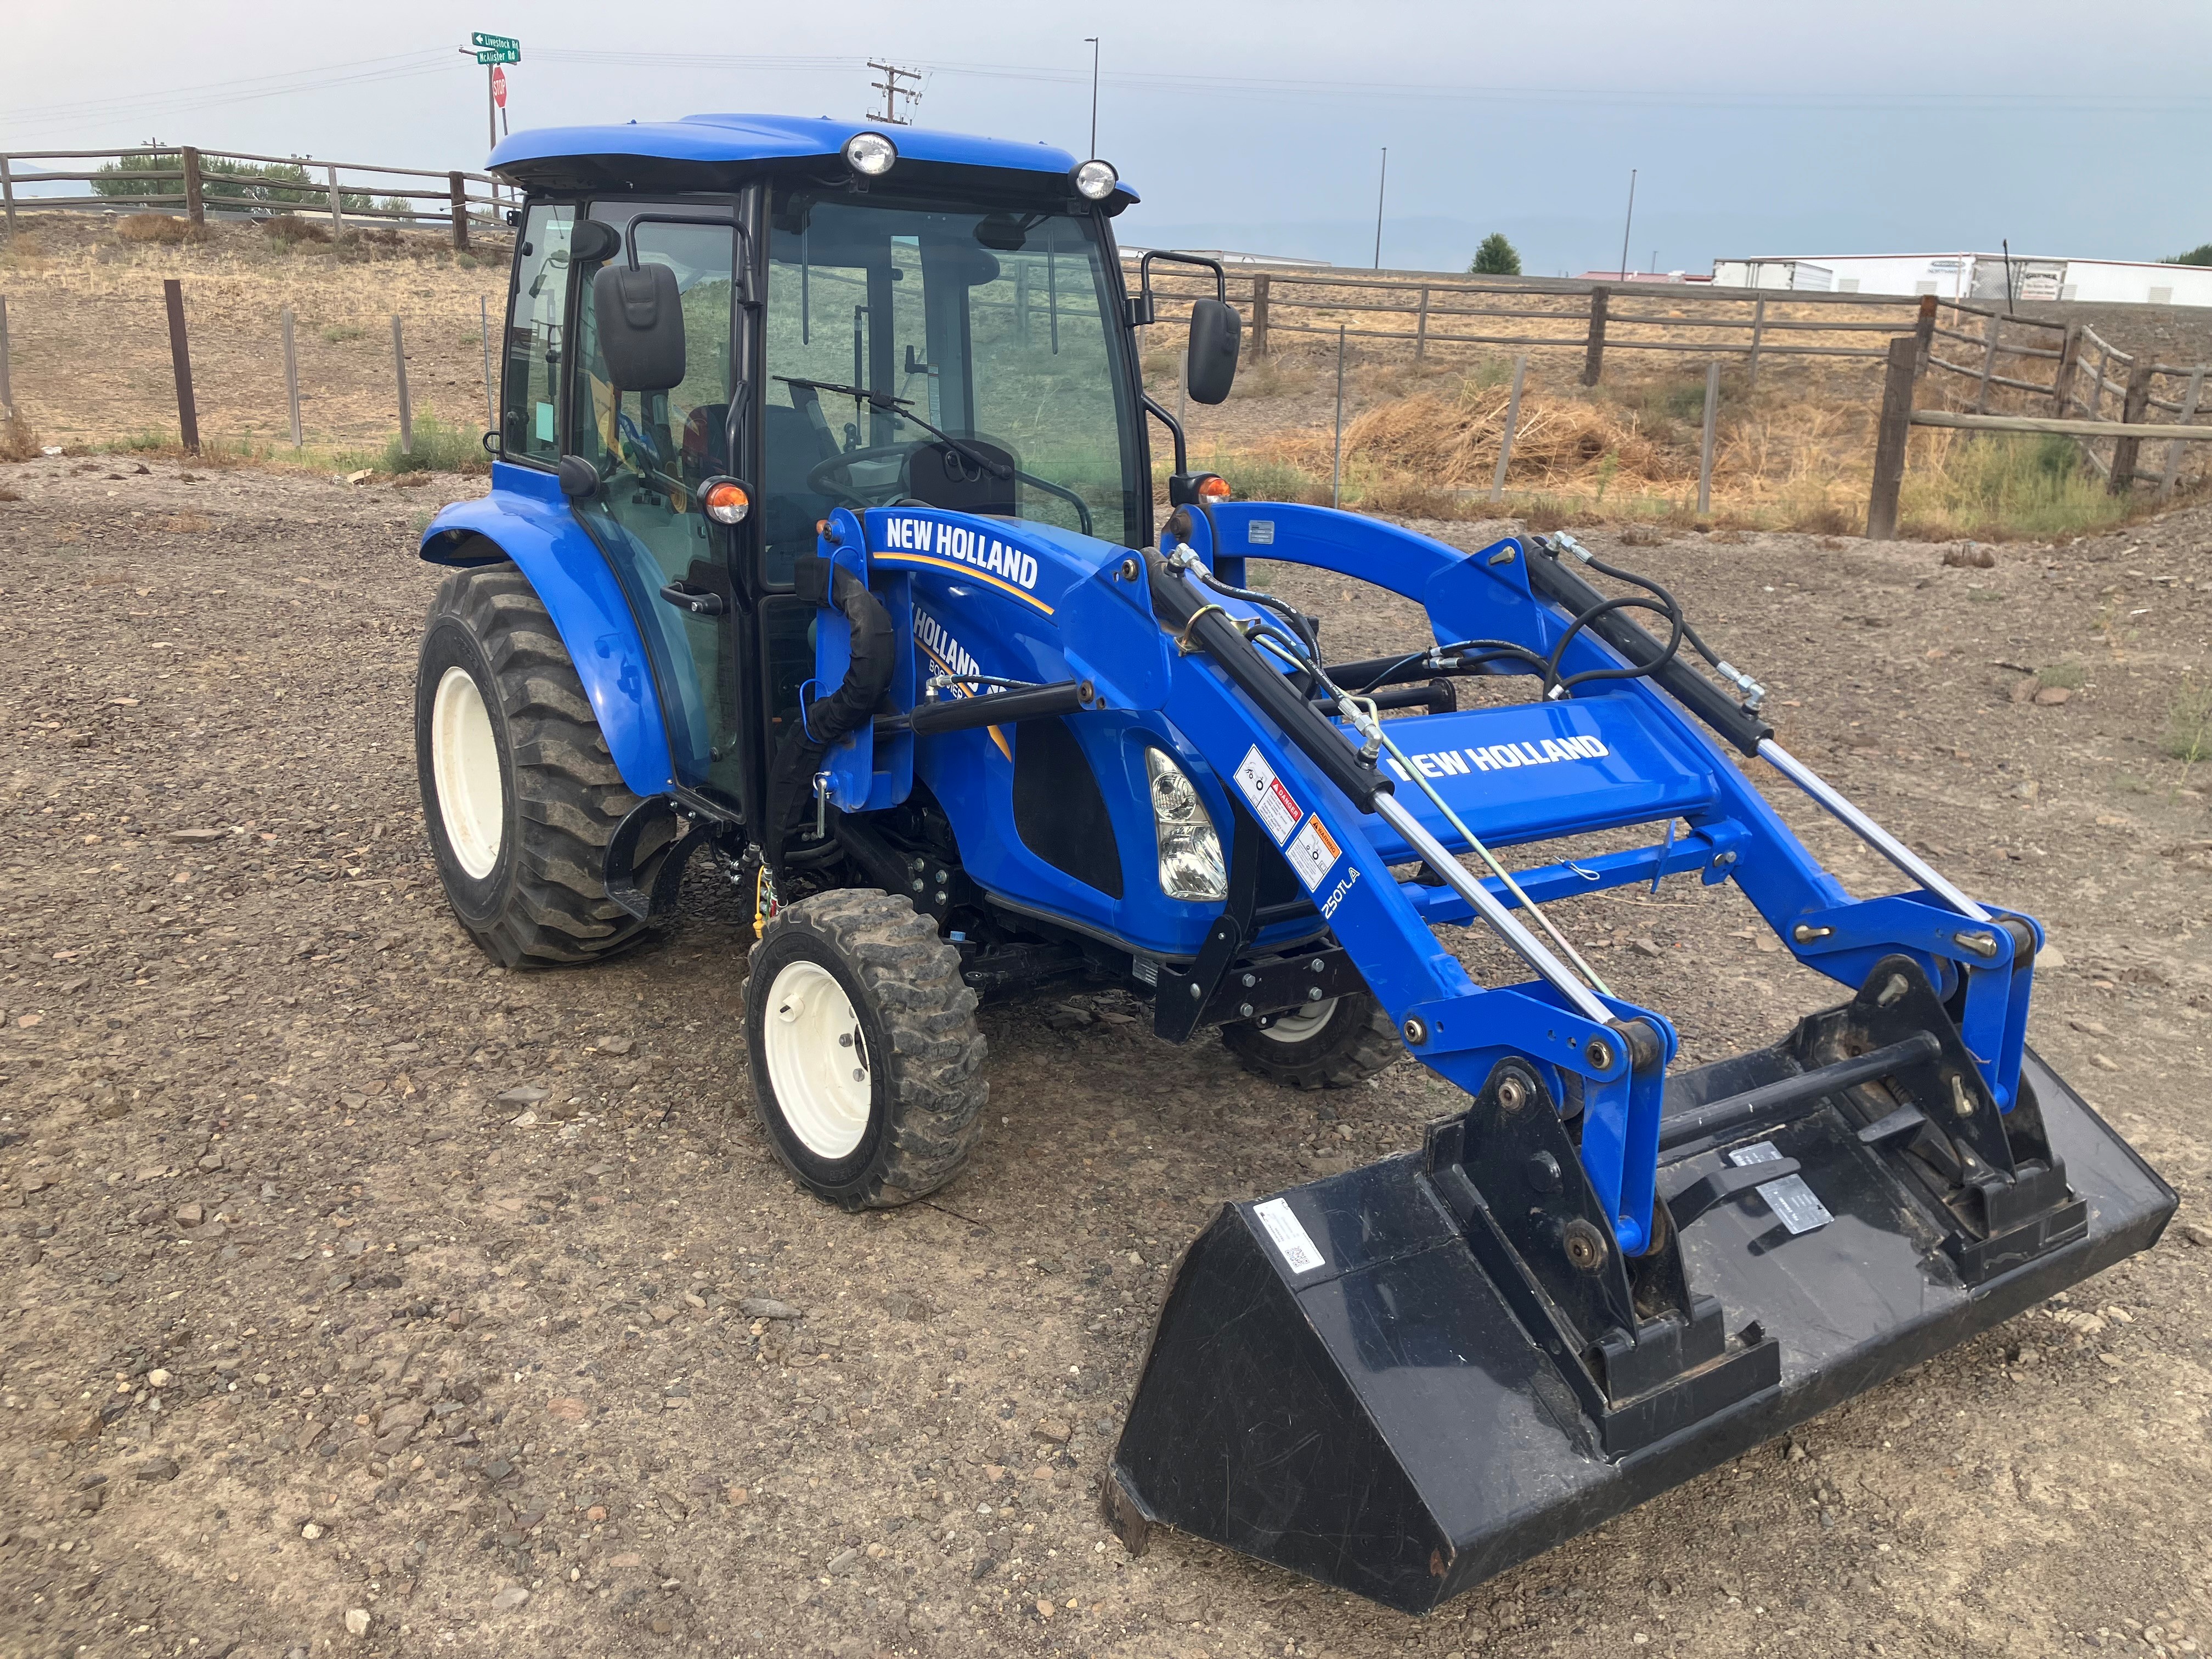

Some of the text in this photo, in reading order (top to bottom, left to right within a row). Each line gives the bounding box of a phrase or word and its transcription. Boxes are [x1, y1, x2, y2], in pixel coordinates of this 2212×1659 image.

[484, 36, 518, 49] Livestock Rd
[507, 50, 515, 60] Rd
[493, 78, 505, 96] STOP
[887, 518, 1037, 589] NEW HOLLAND
[914, 607, 979, 692] HOLLAND
[1386, 735, 1610, 781] NEW HOLLAND
[1277, 789, 1299, 817] DANGER
[1318, 827, 1336, 854] WARNING
[1321, 867, 1361, 919] 250TLA
